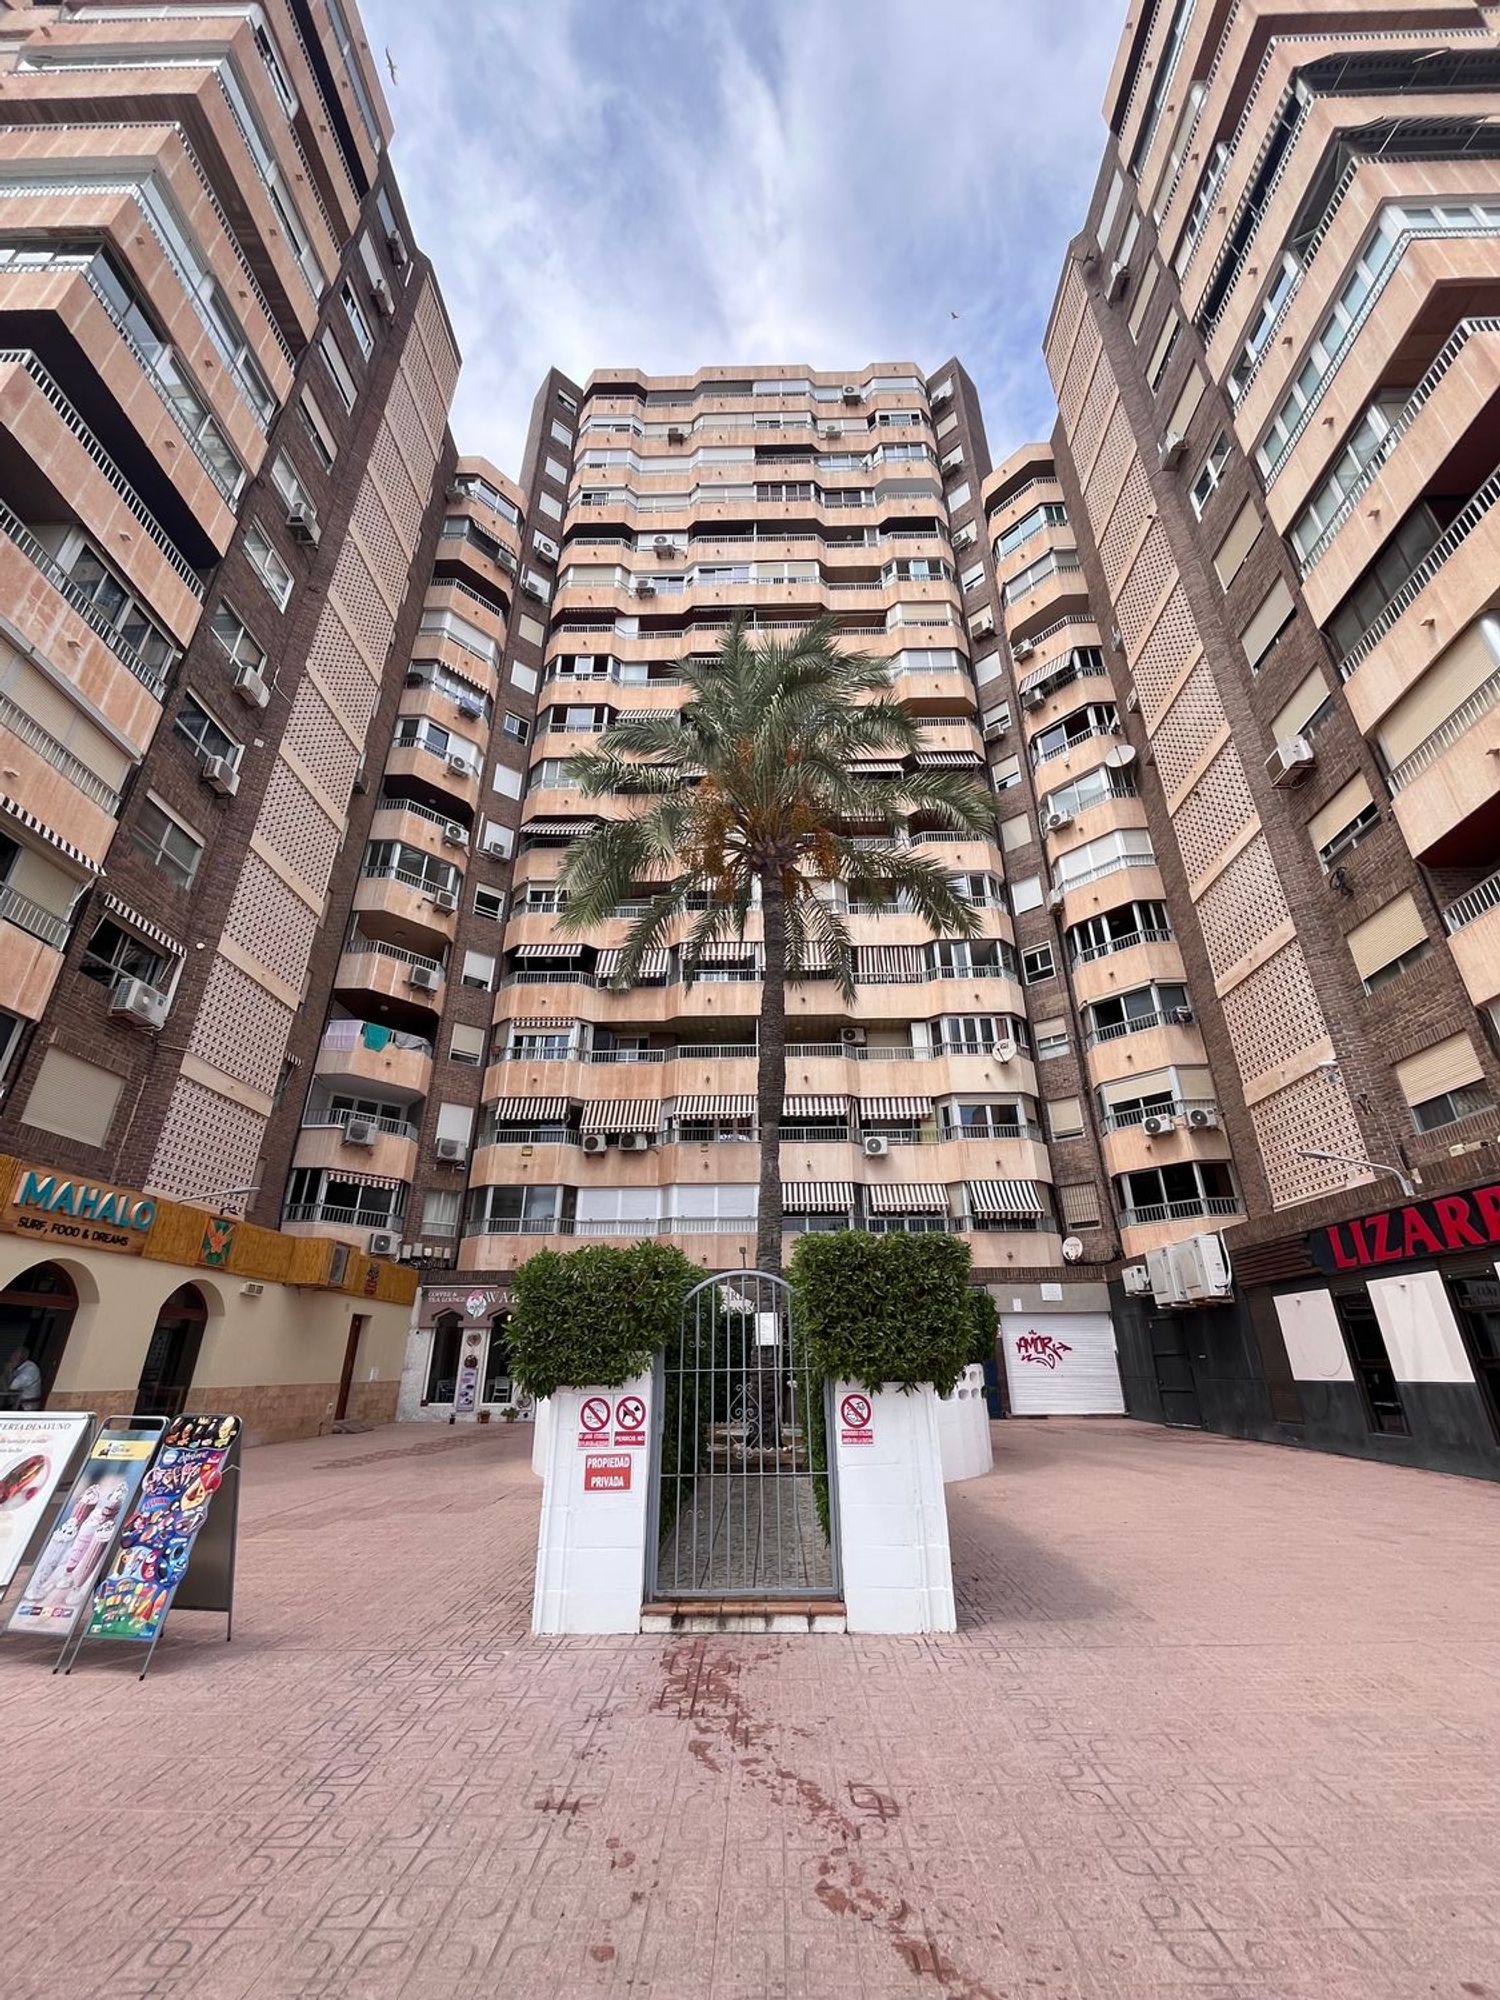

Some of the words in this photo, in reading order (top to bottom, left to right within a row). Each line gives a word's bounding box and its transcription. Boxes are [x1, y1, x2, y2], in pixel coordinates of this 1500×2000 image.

[14, 1171, 156, 1231] MAHALO
[17, 1217, 48, 1233] SURF,
[51, 1222, 80, 1237] FOOD
[82, 1229, 89, 1239] &
[92, 1231, 129, 1246] DREAMS
[586, 1457, 630, 1469] PROPIEDAD
[590, 1476, 624, 1487] PRIVADA
